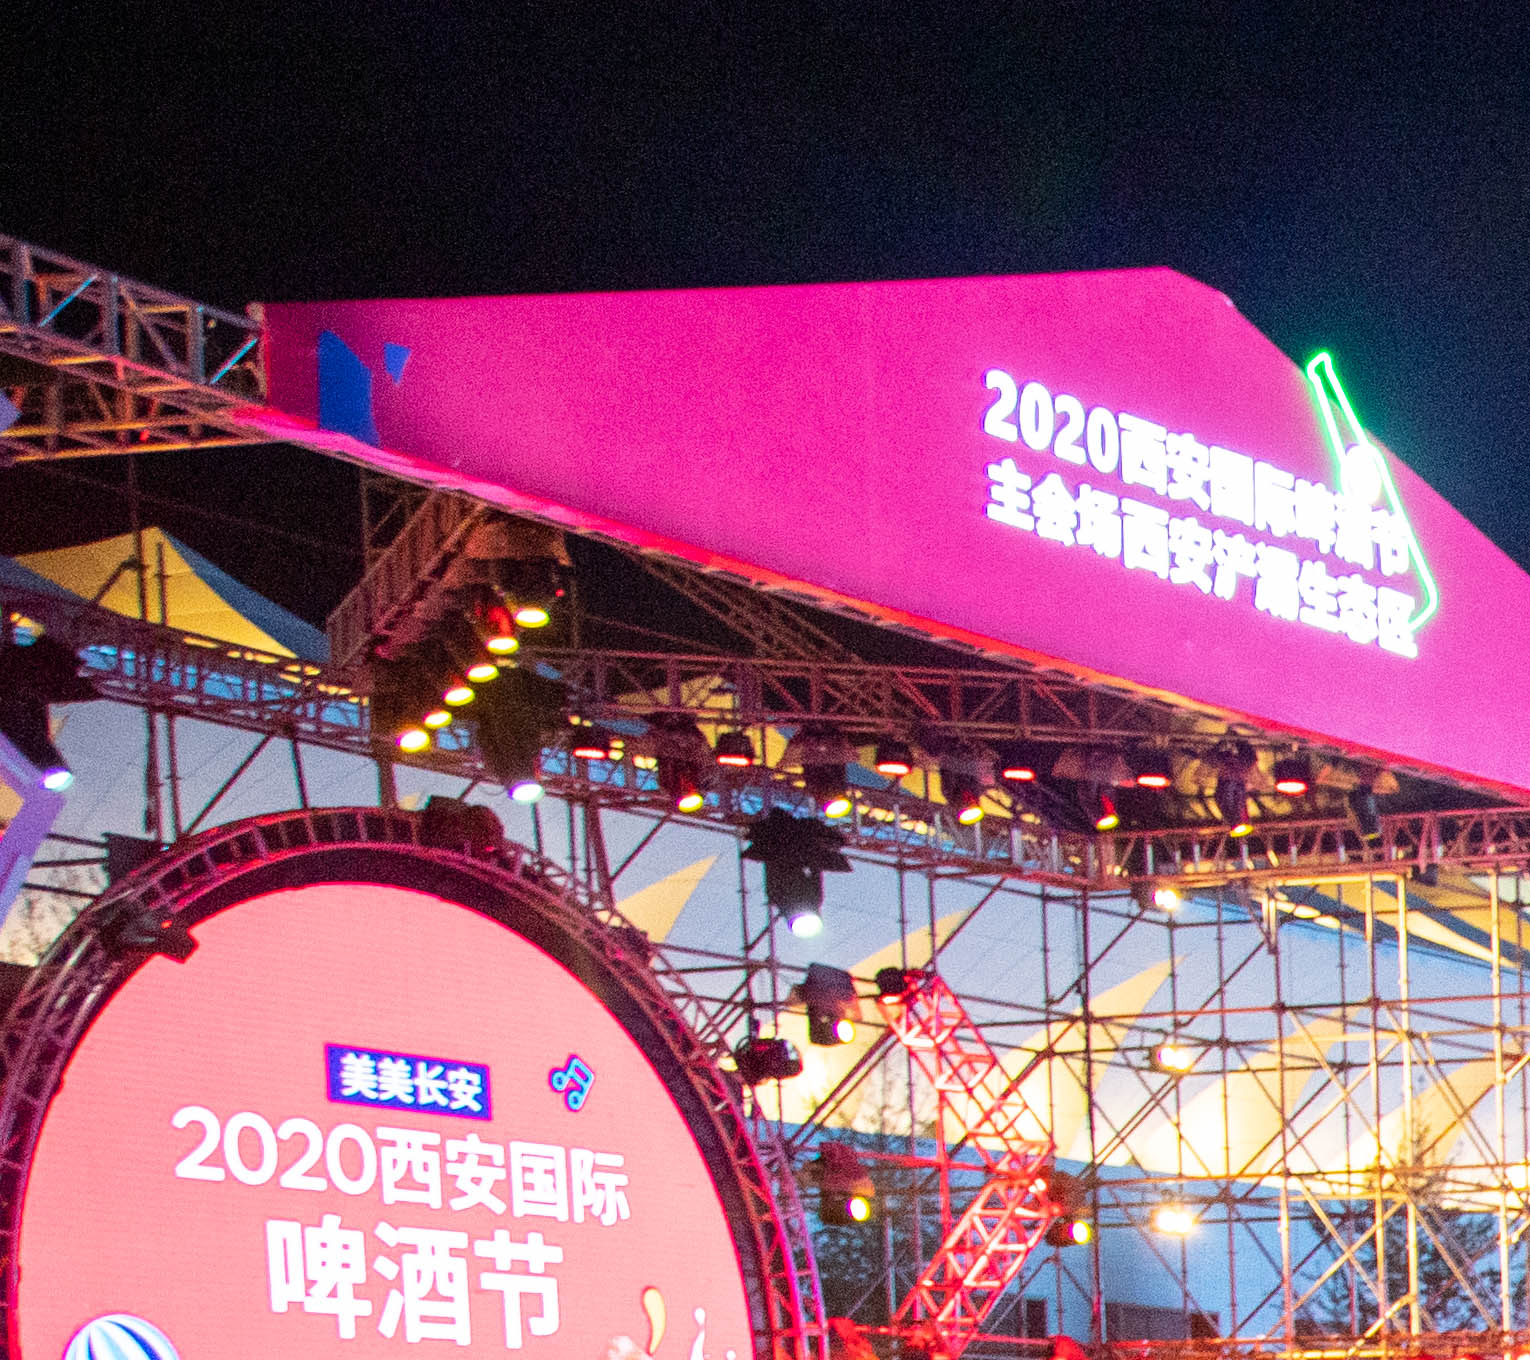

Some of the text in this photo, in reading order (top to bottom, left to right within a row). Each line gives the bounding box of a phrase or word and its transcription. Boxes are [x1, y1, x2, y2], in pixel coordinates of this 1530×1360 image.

[338, 1051, 484, 1112] 美美长安
[171, 1106, 632, 1228] 2020西安国际
[265, 1215, 565, 1350] 啤酒节
